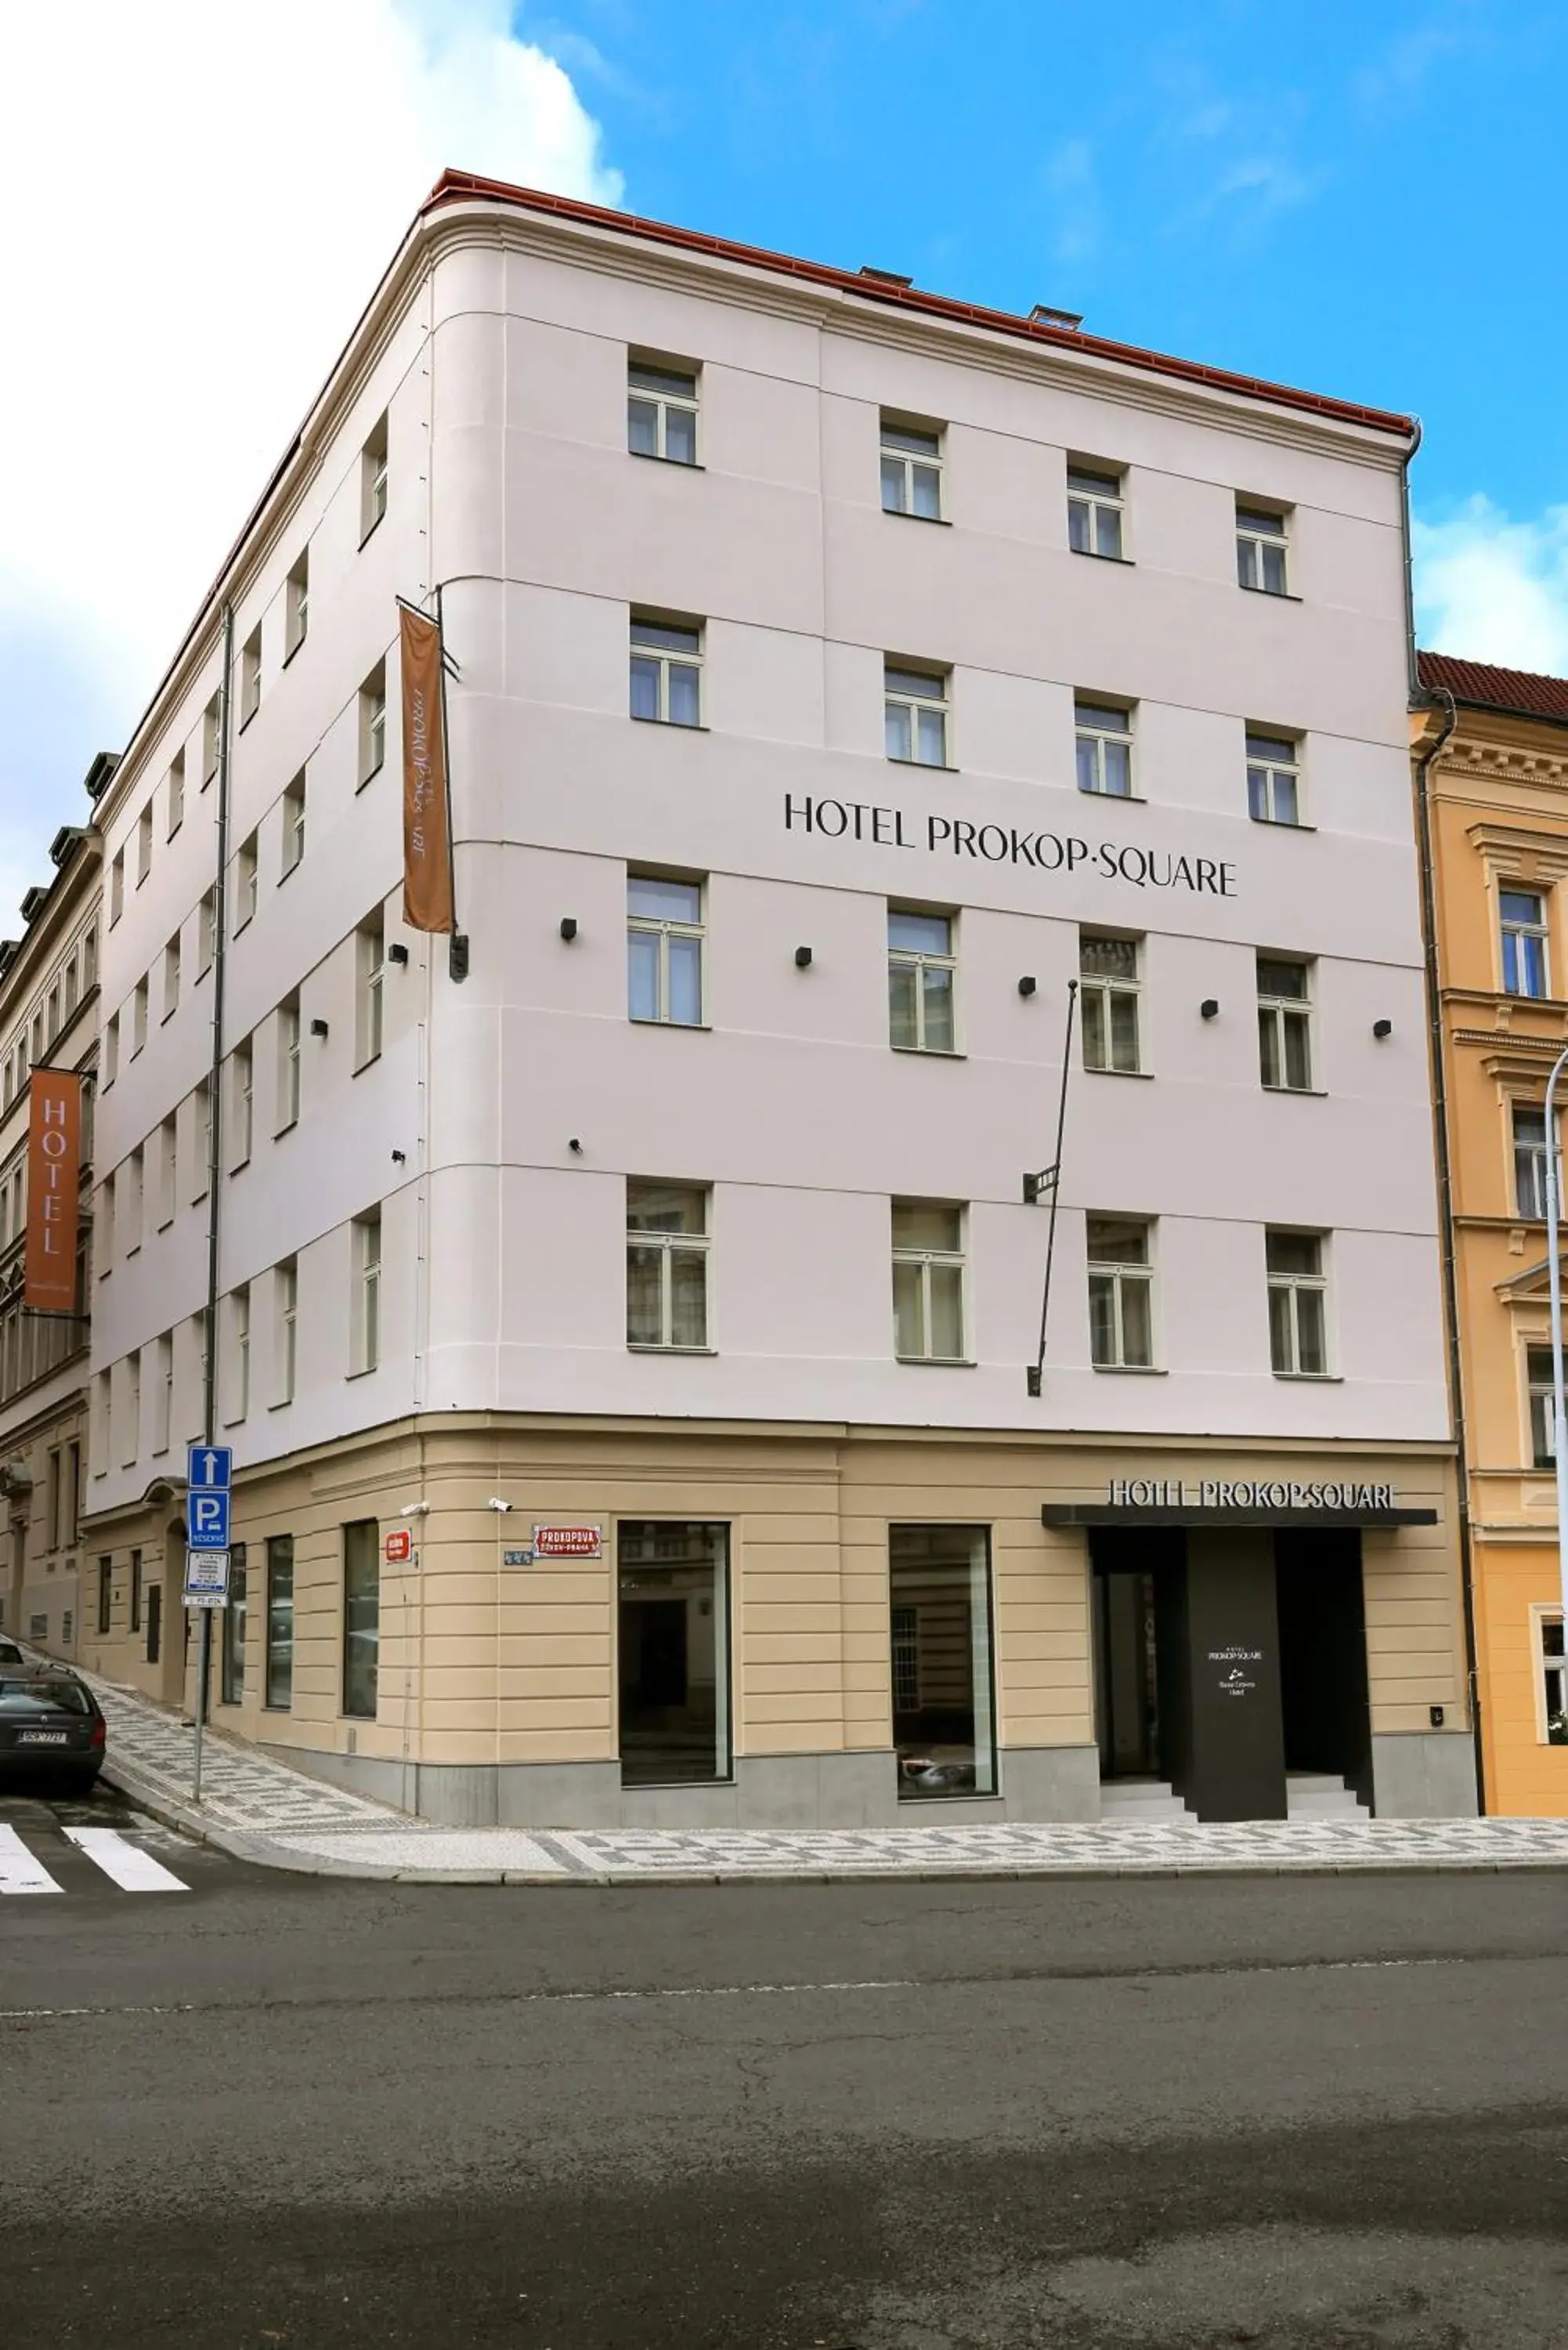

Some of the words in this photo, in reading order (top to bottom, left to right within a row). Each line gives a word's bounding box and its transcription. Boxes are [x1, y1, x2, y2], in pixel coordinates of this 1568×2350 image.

[785, 794, 916, 848] HOTEL
[42, 1098, 67, 1255] HOTEL
[197, 1497, 221, 1531] P
[541, 1531, 594, 1542] PROKOPOVA
